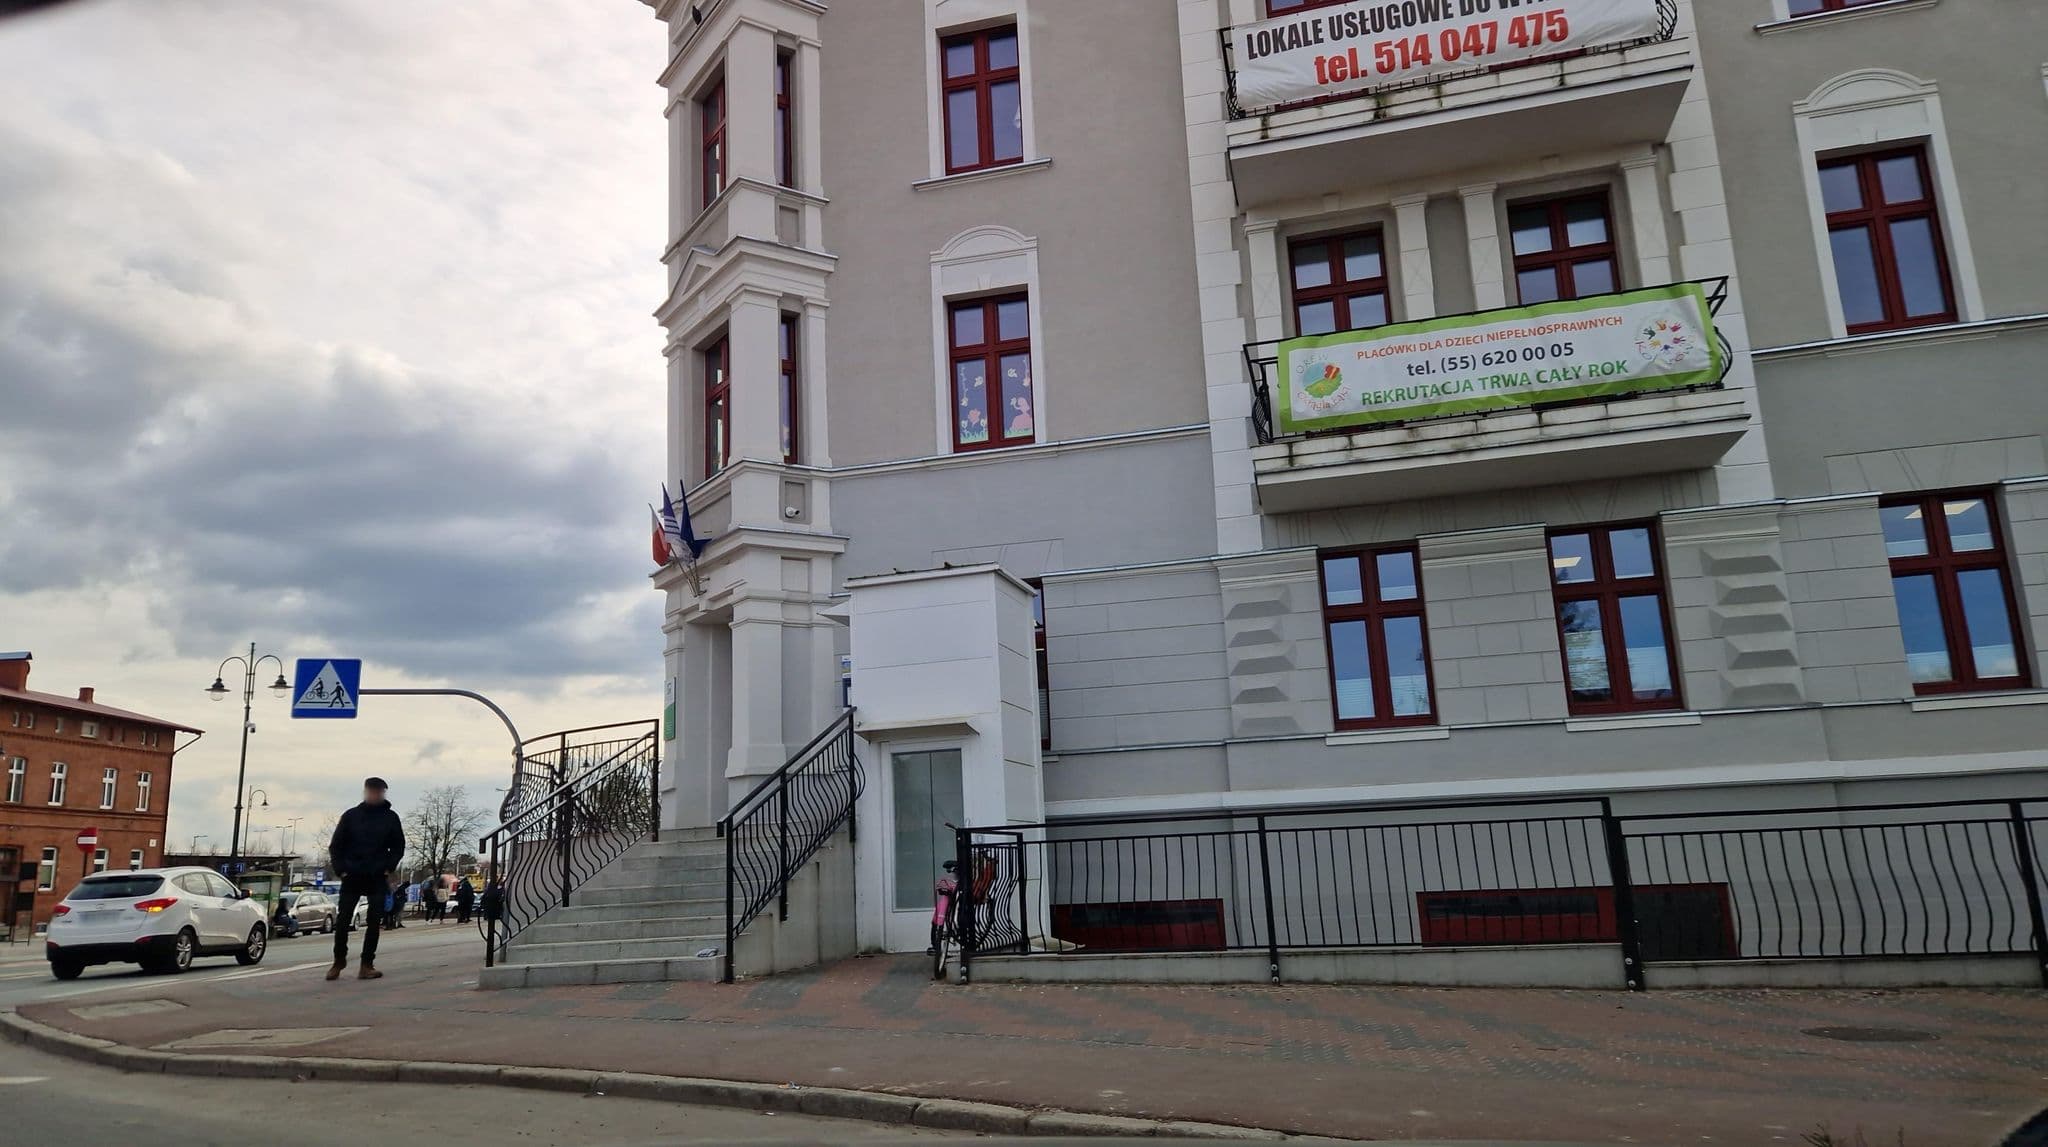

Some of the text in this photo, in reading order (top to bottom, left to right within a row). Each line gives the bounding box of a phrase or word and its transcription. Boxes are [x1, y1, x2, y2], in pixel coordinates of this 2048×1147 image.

[1246, 18, 1324, 60] LOKALE
[1328, 0, 1454, 41] USŁUGOWE
[1314, 9, 1569, 85] tel. 514 047 475
[1357, 316, 1623, 360] PLACÓWKI DLA DZIECI NIEPEŁNOSPRAWNYCH
[1406, 342, 1574, 376] tel. (55) 620 00 05
[1361, 379, 1474, 406] REKRUTACJA
[1478, 371, 1532, 391] TRWA
[1536, 364, 1582, 384] CAŁY
[1588, 359, 1629, 378] ROK
